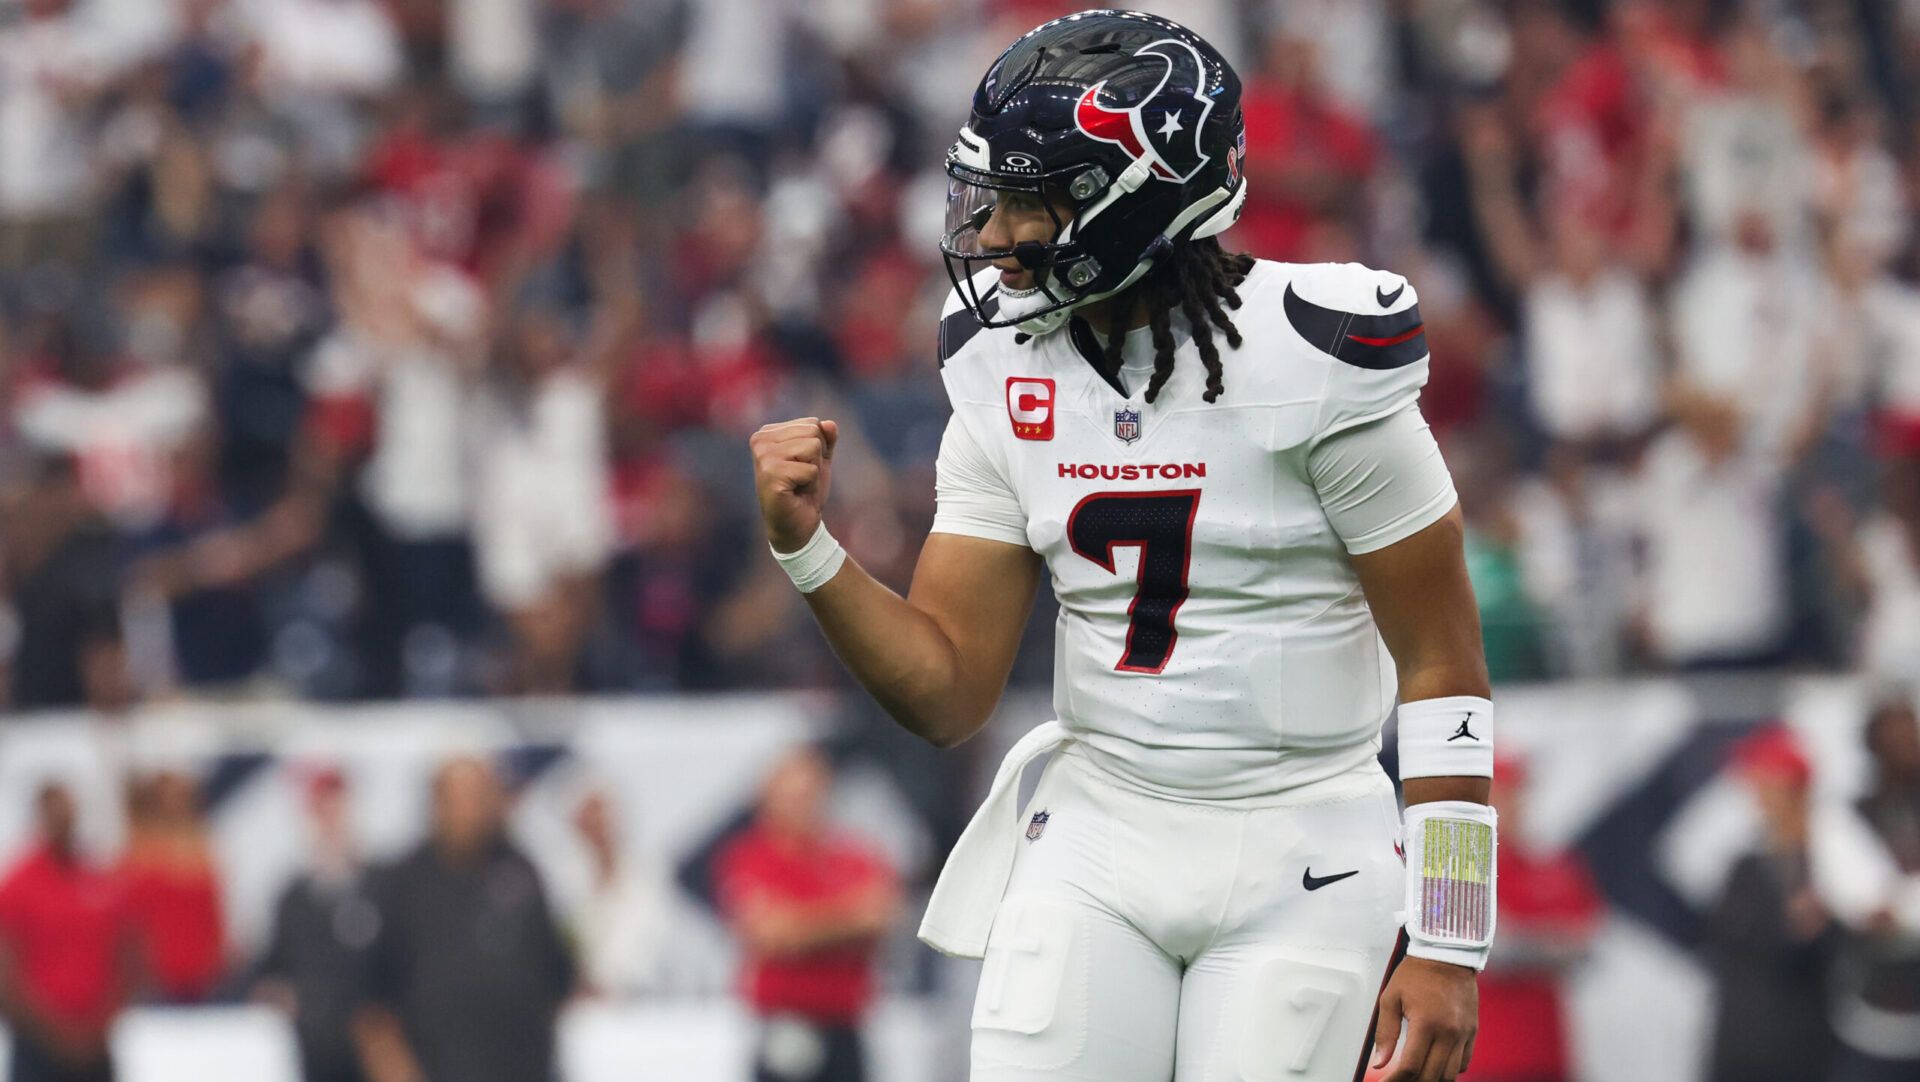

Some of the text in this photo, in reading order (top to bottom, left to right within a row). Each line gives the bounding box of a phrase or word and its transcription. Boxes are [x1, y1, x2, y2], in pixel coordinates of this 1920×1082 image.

[1000, 165, 1038, 173] OAKLEY
[1008, 381, 1050, 424] C
[1118, 423, 1137, 438] NFL
[1058, 463, 1206, 480] HOUSTON
[1067, 488, 1202, 675] 7
[1288, 986, 1341, 1073] 7
